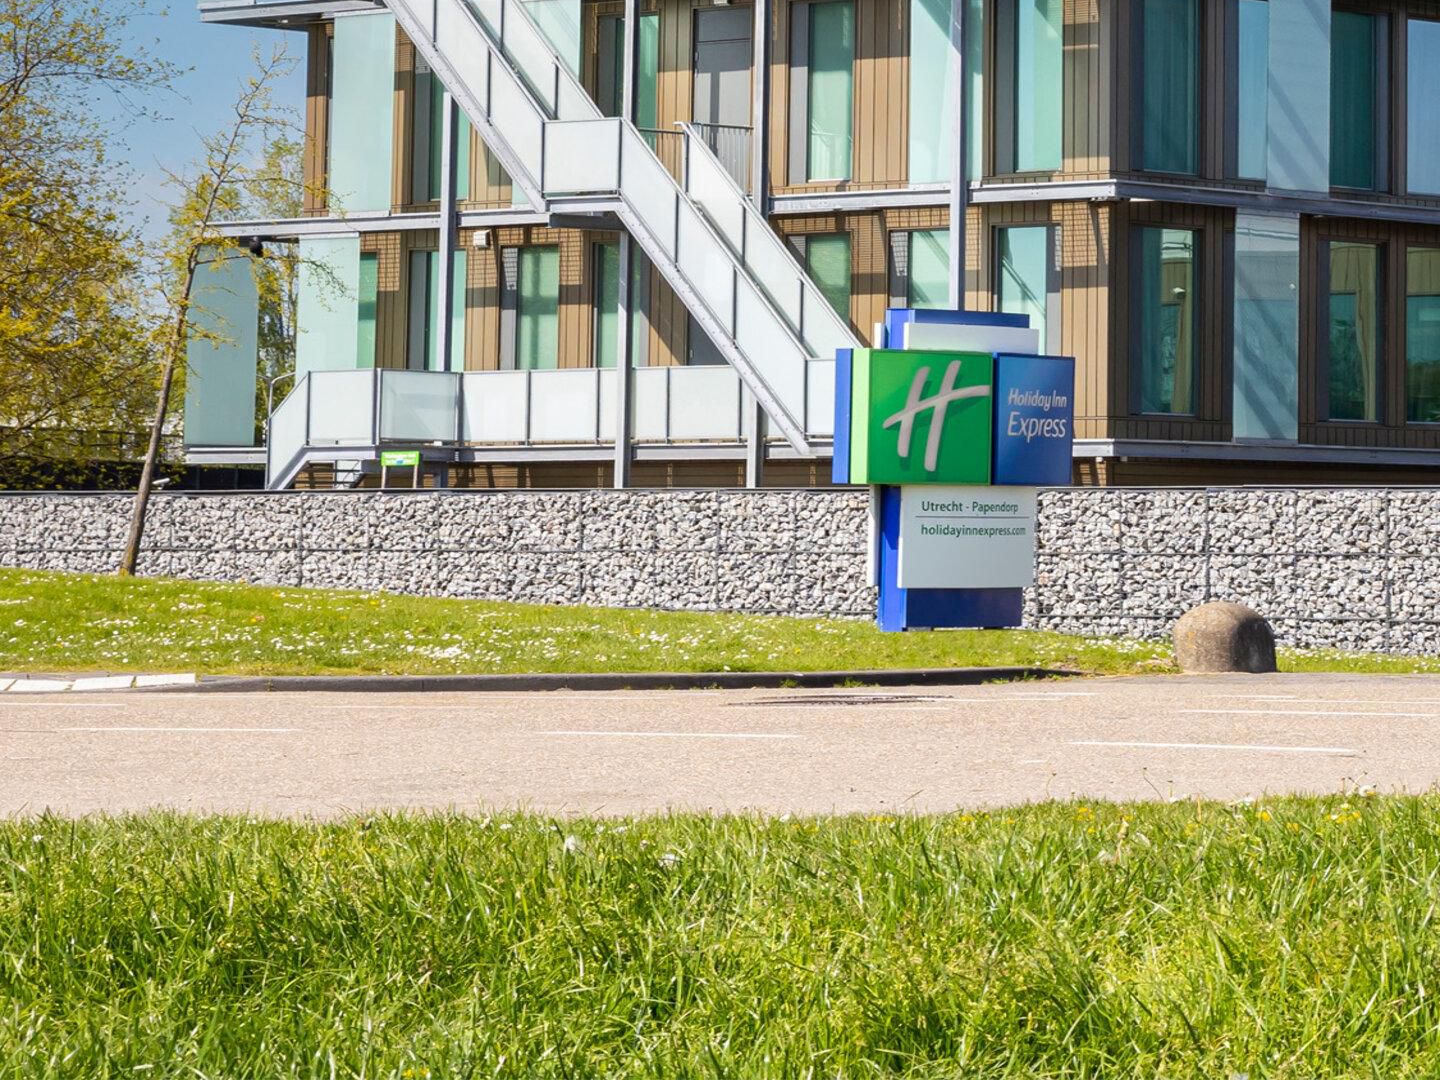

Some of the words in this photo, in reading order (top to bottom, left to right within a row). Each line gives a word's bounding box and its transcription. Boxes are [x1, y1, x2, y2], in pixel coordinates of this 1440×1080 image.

[1008, 388, 1051, 411] Holiday
[1052, 389, 1067, 408] Inn
[882, 359, 991, 472] H
[1008, 411, 1067, 443] Express
[921, 501, 963, 512] Utrecht
[972, 501, 1018, 515] Papendorp
[921, 524, 1026, 538] holidayinnexpress.com
